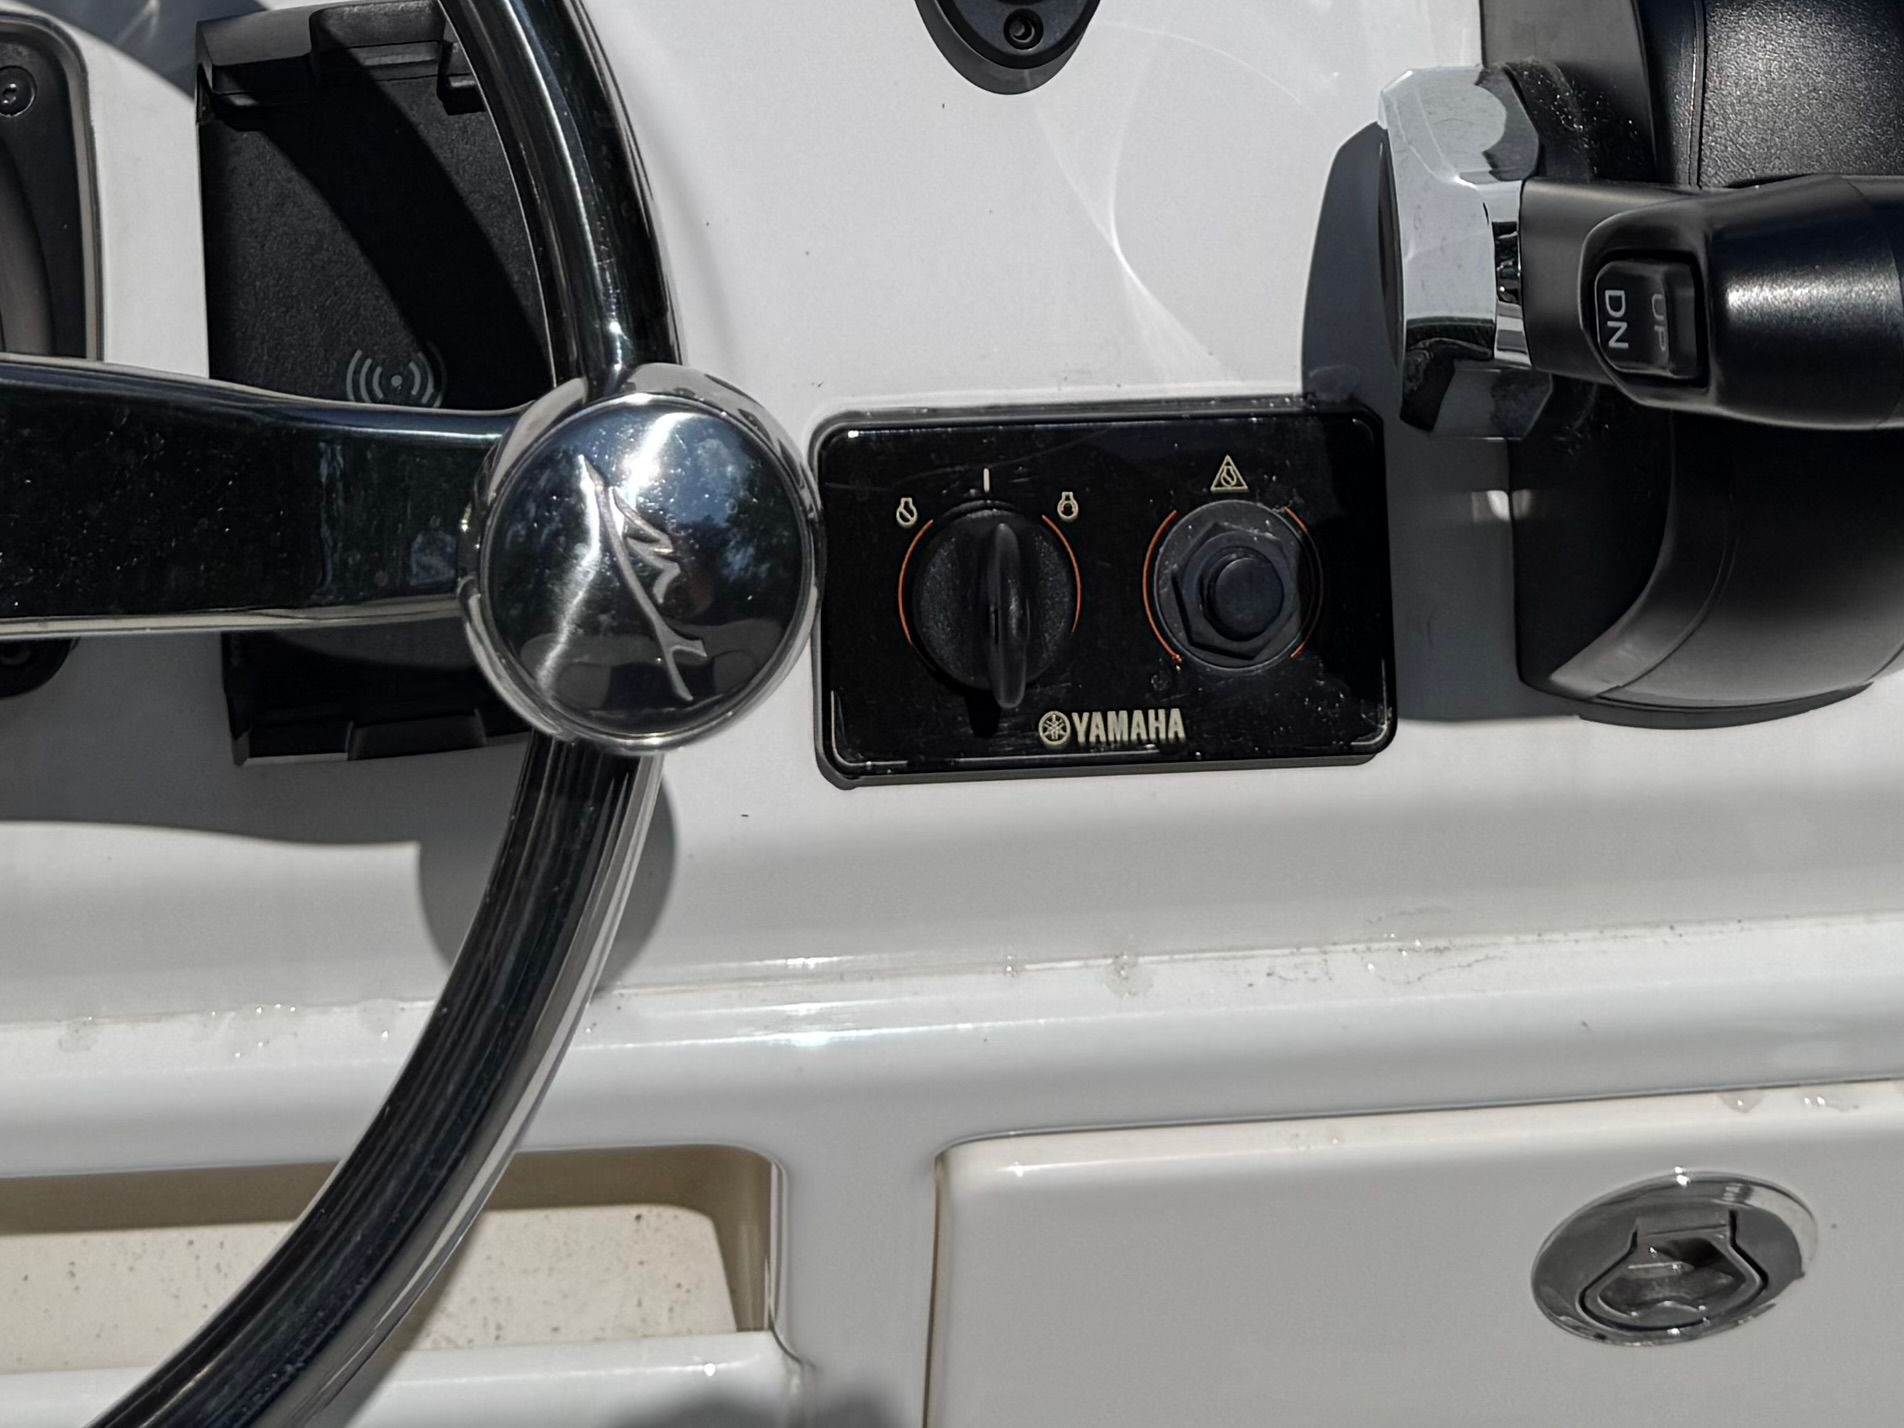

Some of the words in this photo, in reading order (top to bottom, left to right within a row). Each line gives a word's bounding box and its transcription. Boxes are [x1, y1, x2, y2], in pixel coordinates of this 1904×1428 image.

[1604, 289, 1629, 350] DN
[1651, 293, 1669, 352] UP
[1069, 708, 1186, 744] YAMAHA
